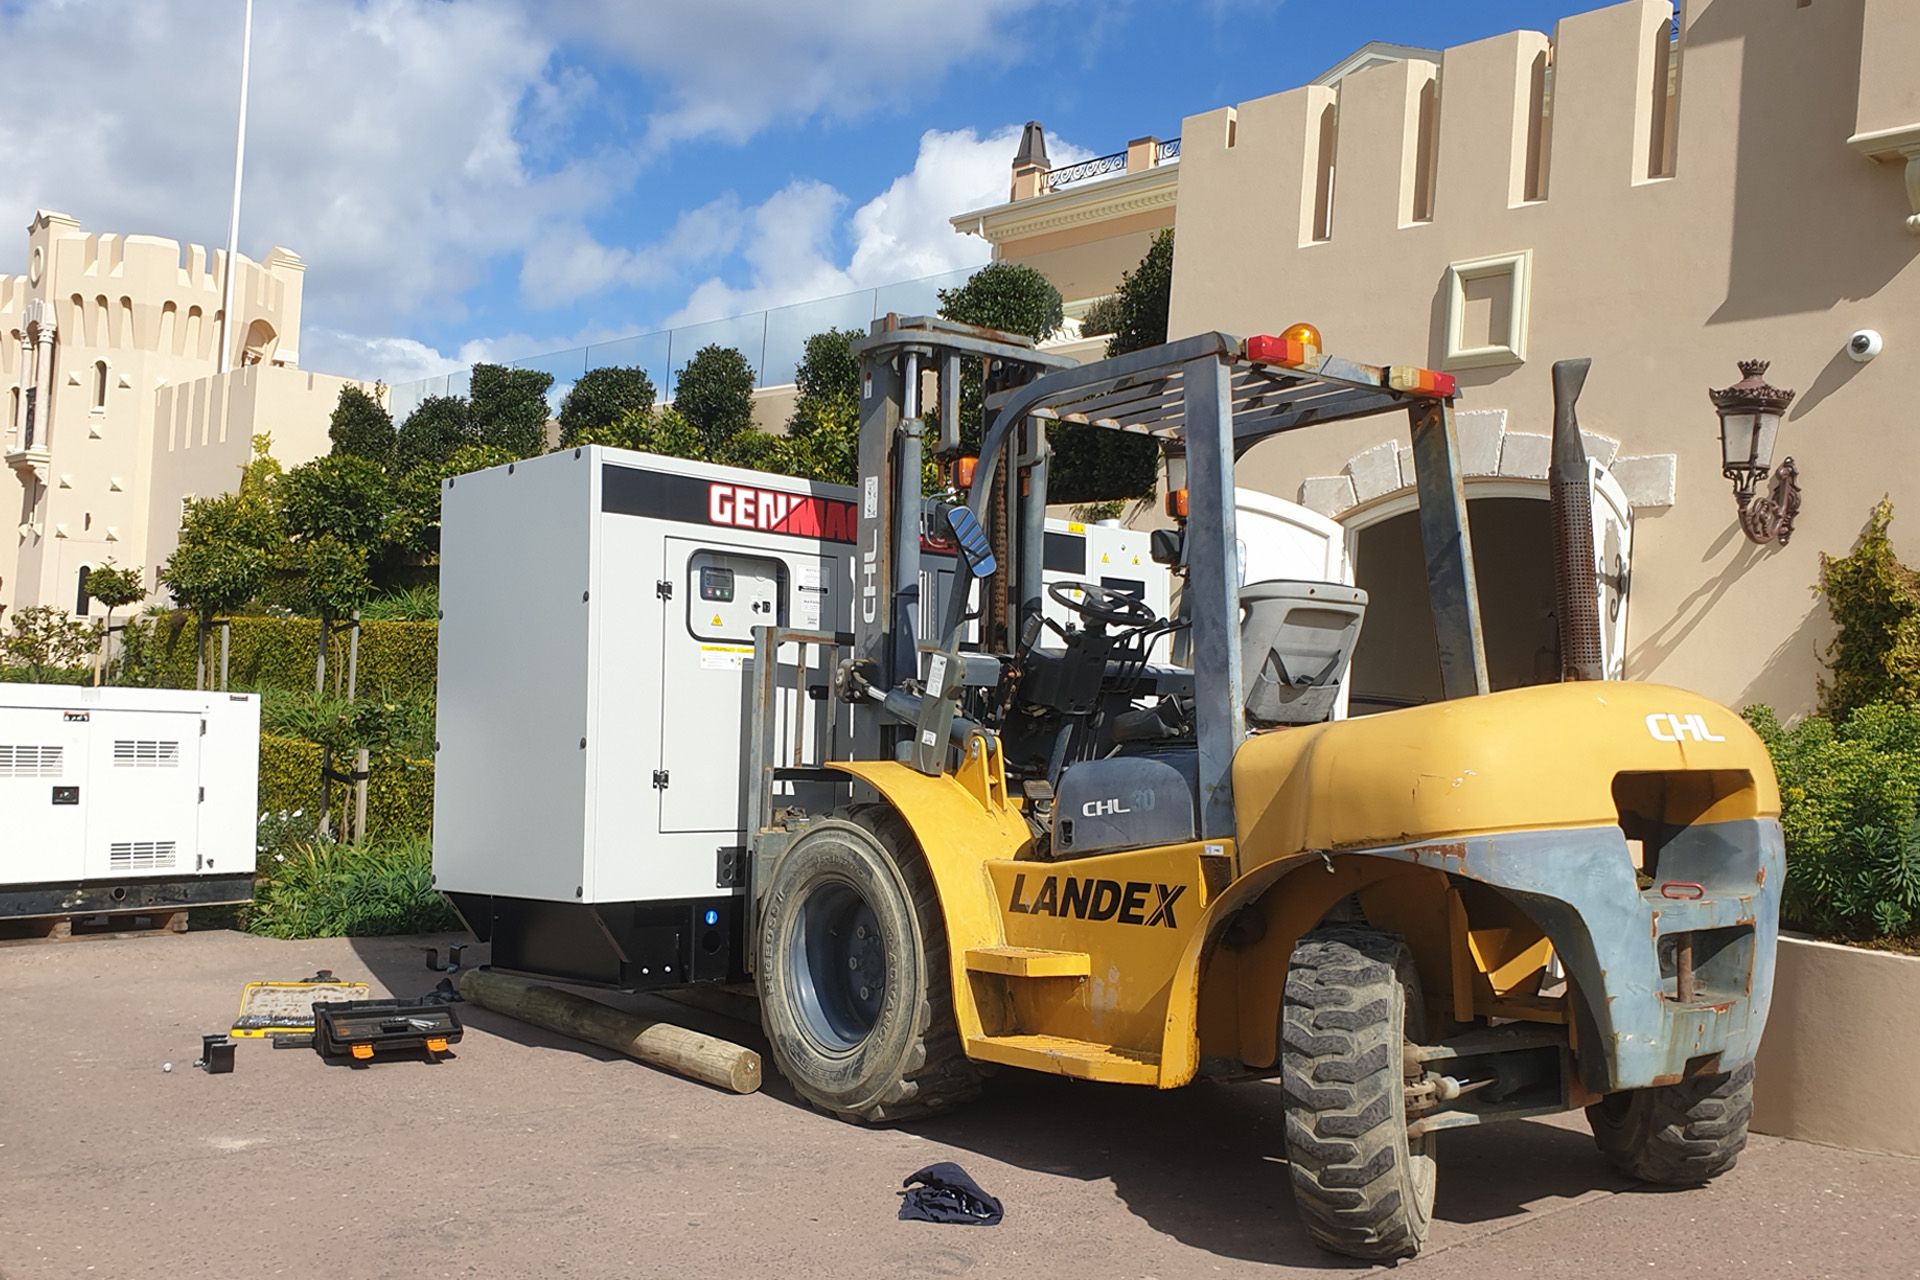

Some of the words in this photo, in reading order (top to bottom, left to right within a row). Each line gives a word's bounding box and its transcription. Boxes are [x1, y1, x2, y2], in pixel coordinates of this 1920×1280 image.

[863, 528, 877, 623] CHL
[1645, 713, 1726, 742] CHL
[1082, 798, 1131, 817] CHL
[1008, 873, 1188, 929] LANDEX
